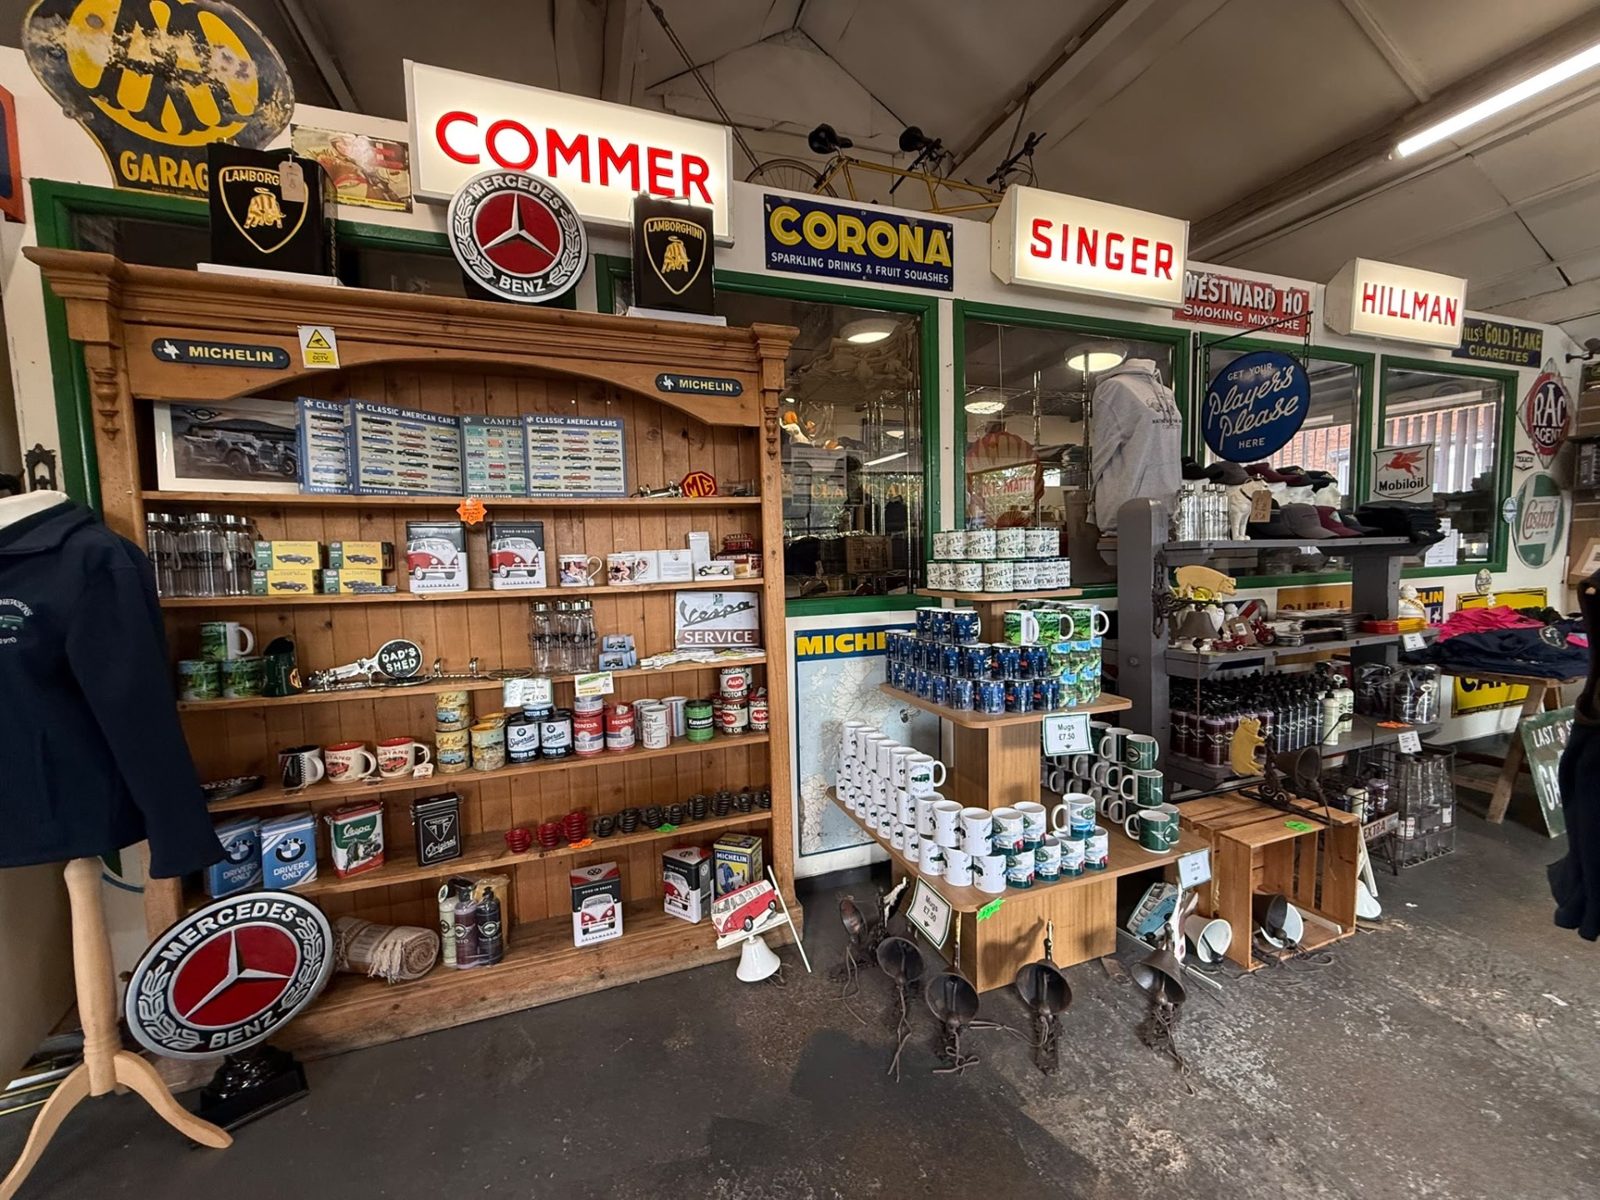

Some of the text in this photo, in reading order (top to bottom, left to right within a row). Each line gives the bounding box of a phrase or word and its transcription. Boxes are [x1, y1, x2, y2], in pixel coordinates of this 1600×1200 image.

[436, 111, 714, 204] COMMER
[119, 150, 209, 193] GARAG
[225, 168, 280, 186] LAMBORG
[468, 175, 562, 210] MERCEDES
[647, 220, 703, 240] LAMBORGHINI
[1030, 217, 1174, 281] SINGER
[771, 251, 949, 285] SPARKLING DRINKS & FRUIT SQUASHES
[498, 275, 547, 293] BENZ
[1184, 271, 1276, 312] WESTWARD
[1361, 282, 1457, 327] HILLMAN
[1183, 304, 1300, 330] SMOKING MIXTURE
[1512, 327, 1541, 350] FLAKE
[189, 345, 275, 363] MICHELIN
[1468, 344, 1529, 363] CIGARETTES
[1227, 362, 1273, 381] GET YOUR
[679, 378, 734, 392] MICHELIN
[316, 402, 344, 411] CLASS
[366, 404, 456, 425] CLASSIC AMERICAN CARS
[1533, 384, 1567, 428] RAC
[535, 416, 618, 427] CLASSIC AMERICAN CARS
[1219, 395, 1299, 451] Please
[1238, 437, 1266, 449] HERE
[1534, 427, 1562, 444] AGENT
[684, 475, 716, 497] MG
[1378, 476, 1424, 492] Mobiloil
[679, 600, 756, 628] Vespa
[684, 630, 753, 644] SERVICE
[381, 647, 417, 662] DAD'S
[385, 659, 417, 673] SHED
[1057, 724, 1075, 732] Mugs
[1058, 732, 1075, 741] £7.50
[1531, 725, 1556, 748] LAST
[1363, 819, 1387, 839] EXTRA
[716, 852, 747, 863] MICHELIN
[223, 863, 258, 880] DRIVERS
[231, 871, 252, 883] ONLY
[273, 860, 310, 876] DRIVERS
[281, 870, 303, 881] ONLY
[925, 894, 939, 913] Mugs
[159, 902, 298, 962] MERCEDES
[208, 1010, 278, 1049] BENZ
